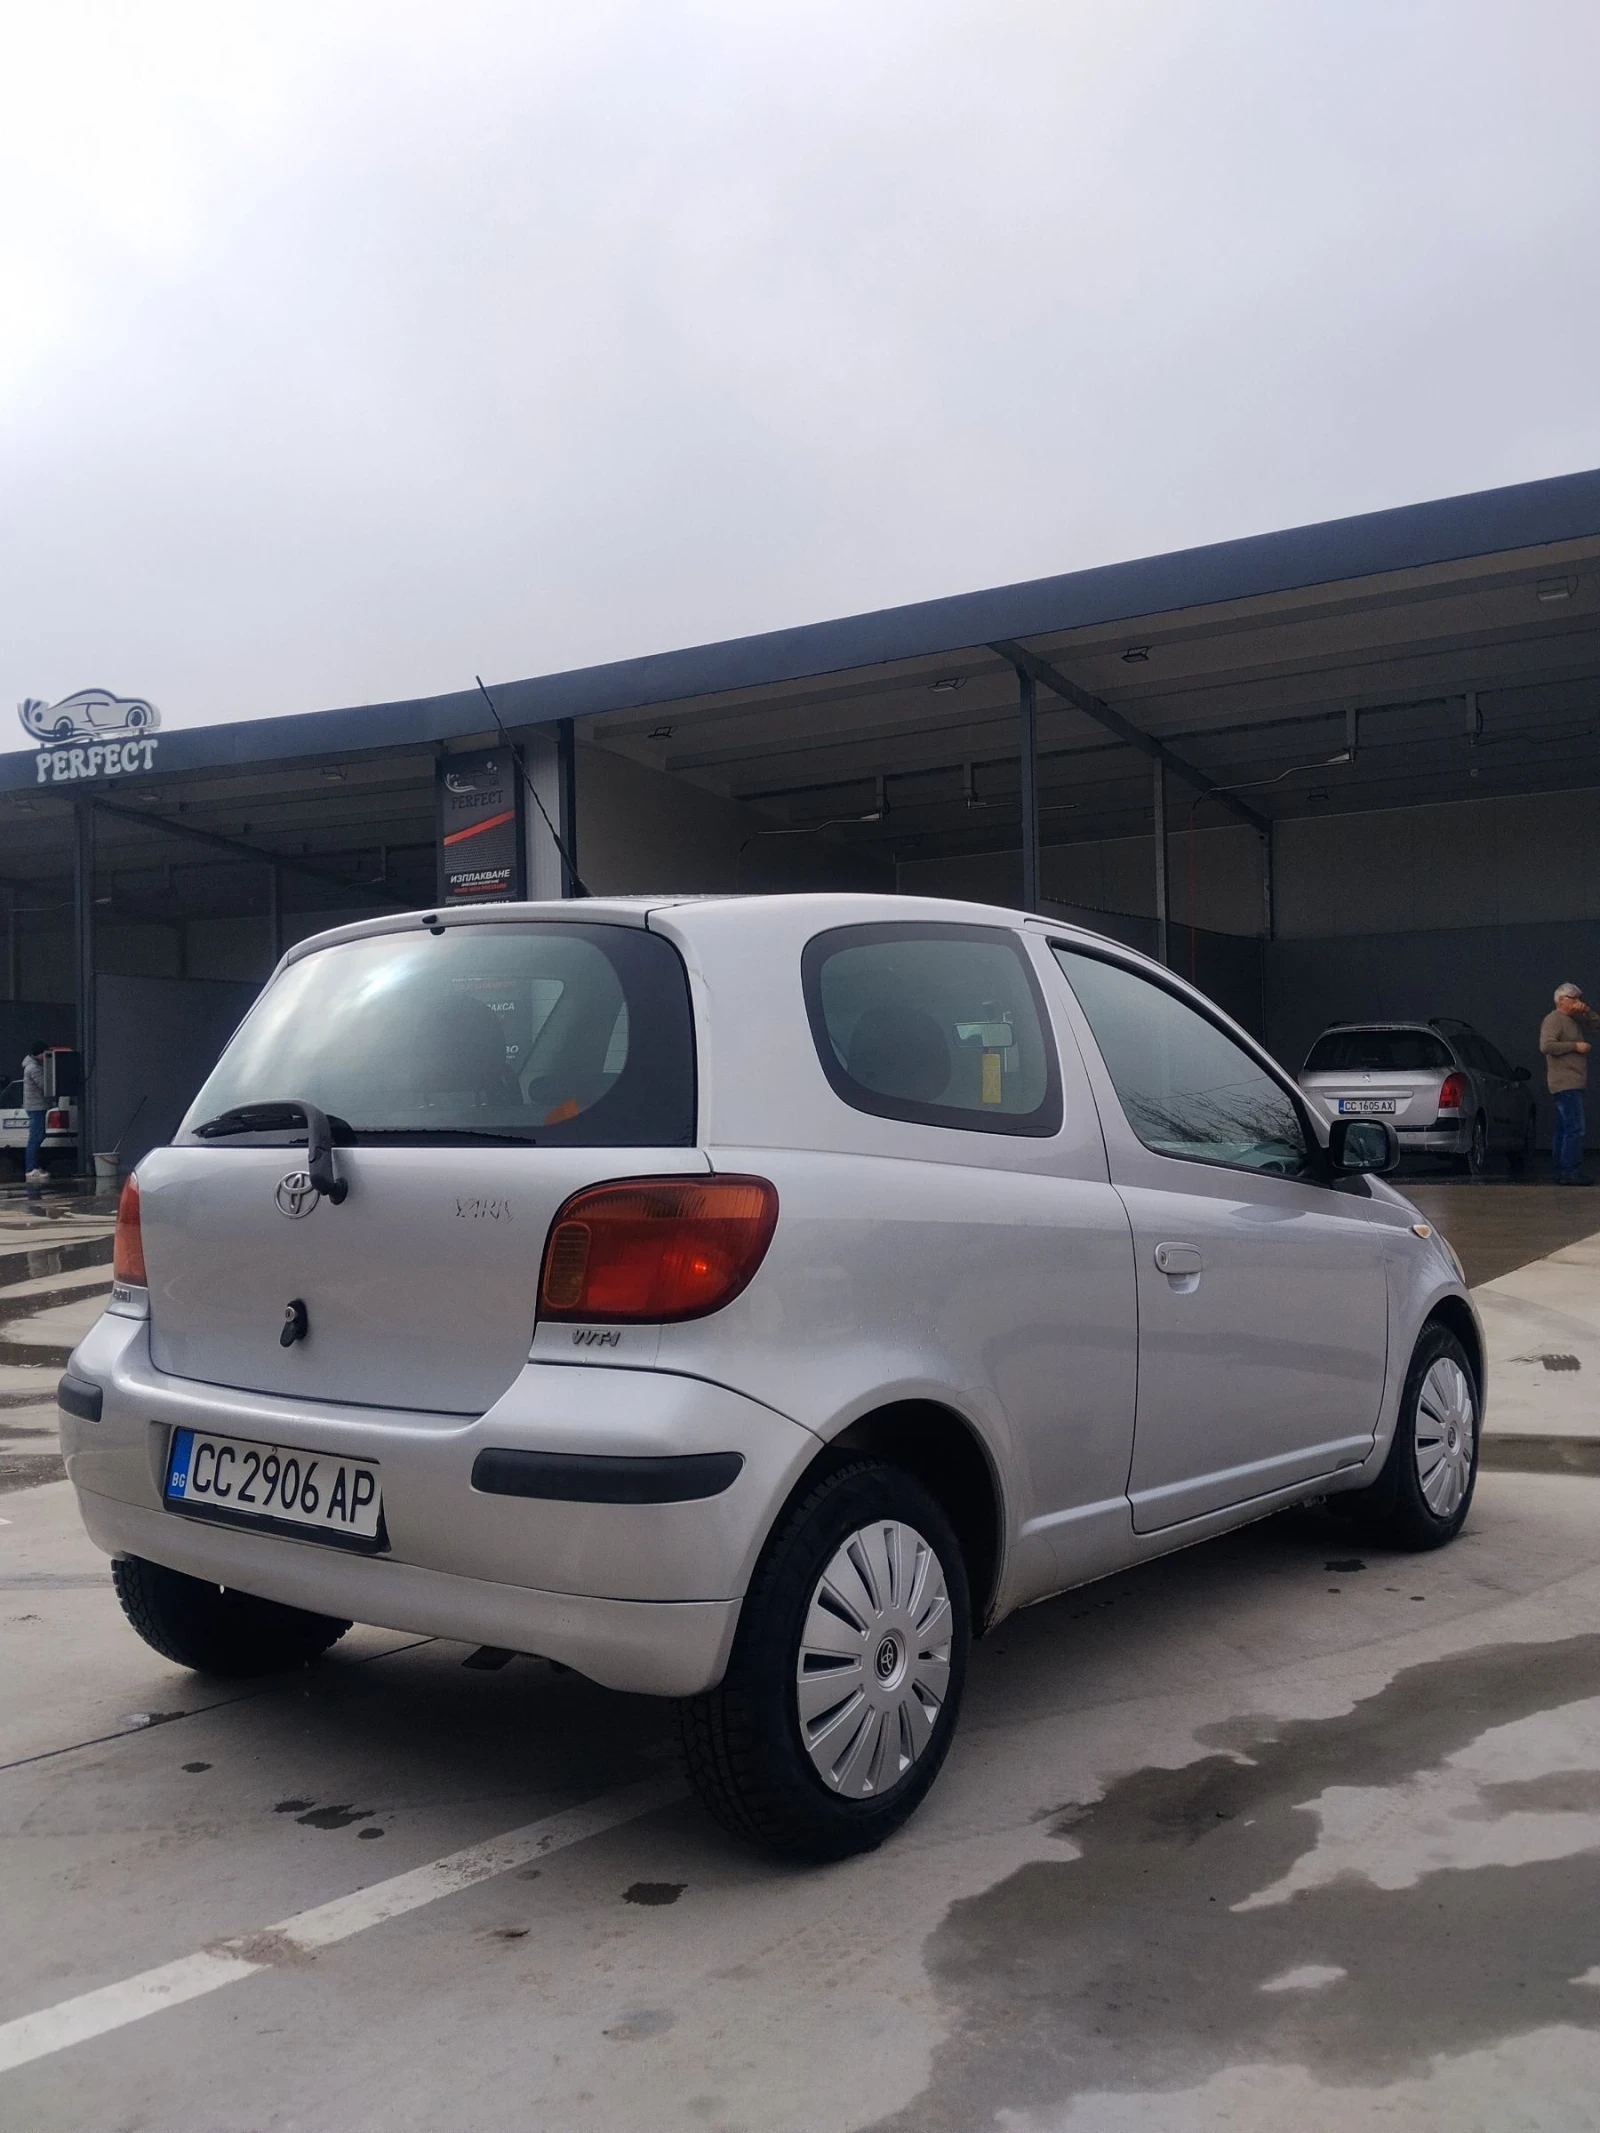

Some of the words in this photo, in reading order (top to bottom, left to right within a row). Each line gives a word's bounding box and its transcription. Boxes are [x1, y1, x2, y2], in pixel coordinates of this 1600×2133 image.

[35, 739, 158, 783] PERFECT
[450, 868, 511, 884] ИЗПЛАКВАНЕ
[171, 1471, 186, 1488] BG
